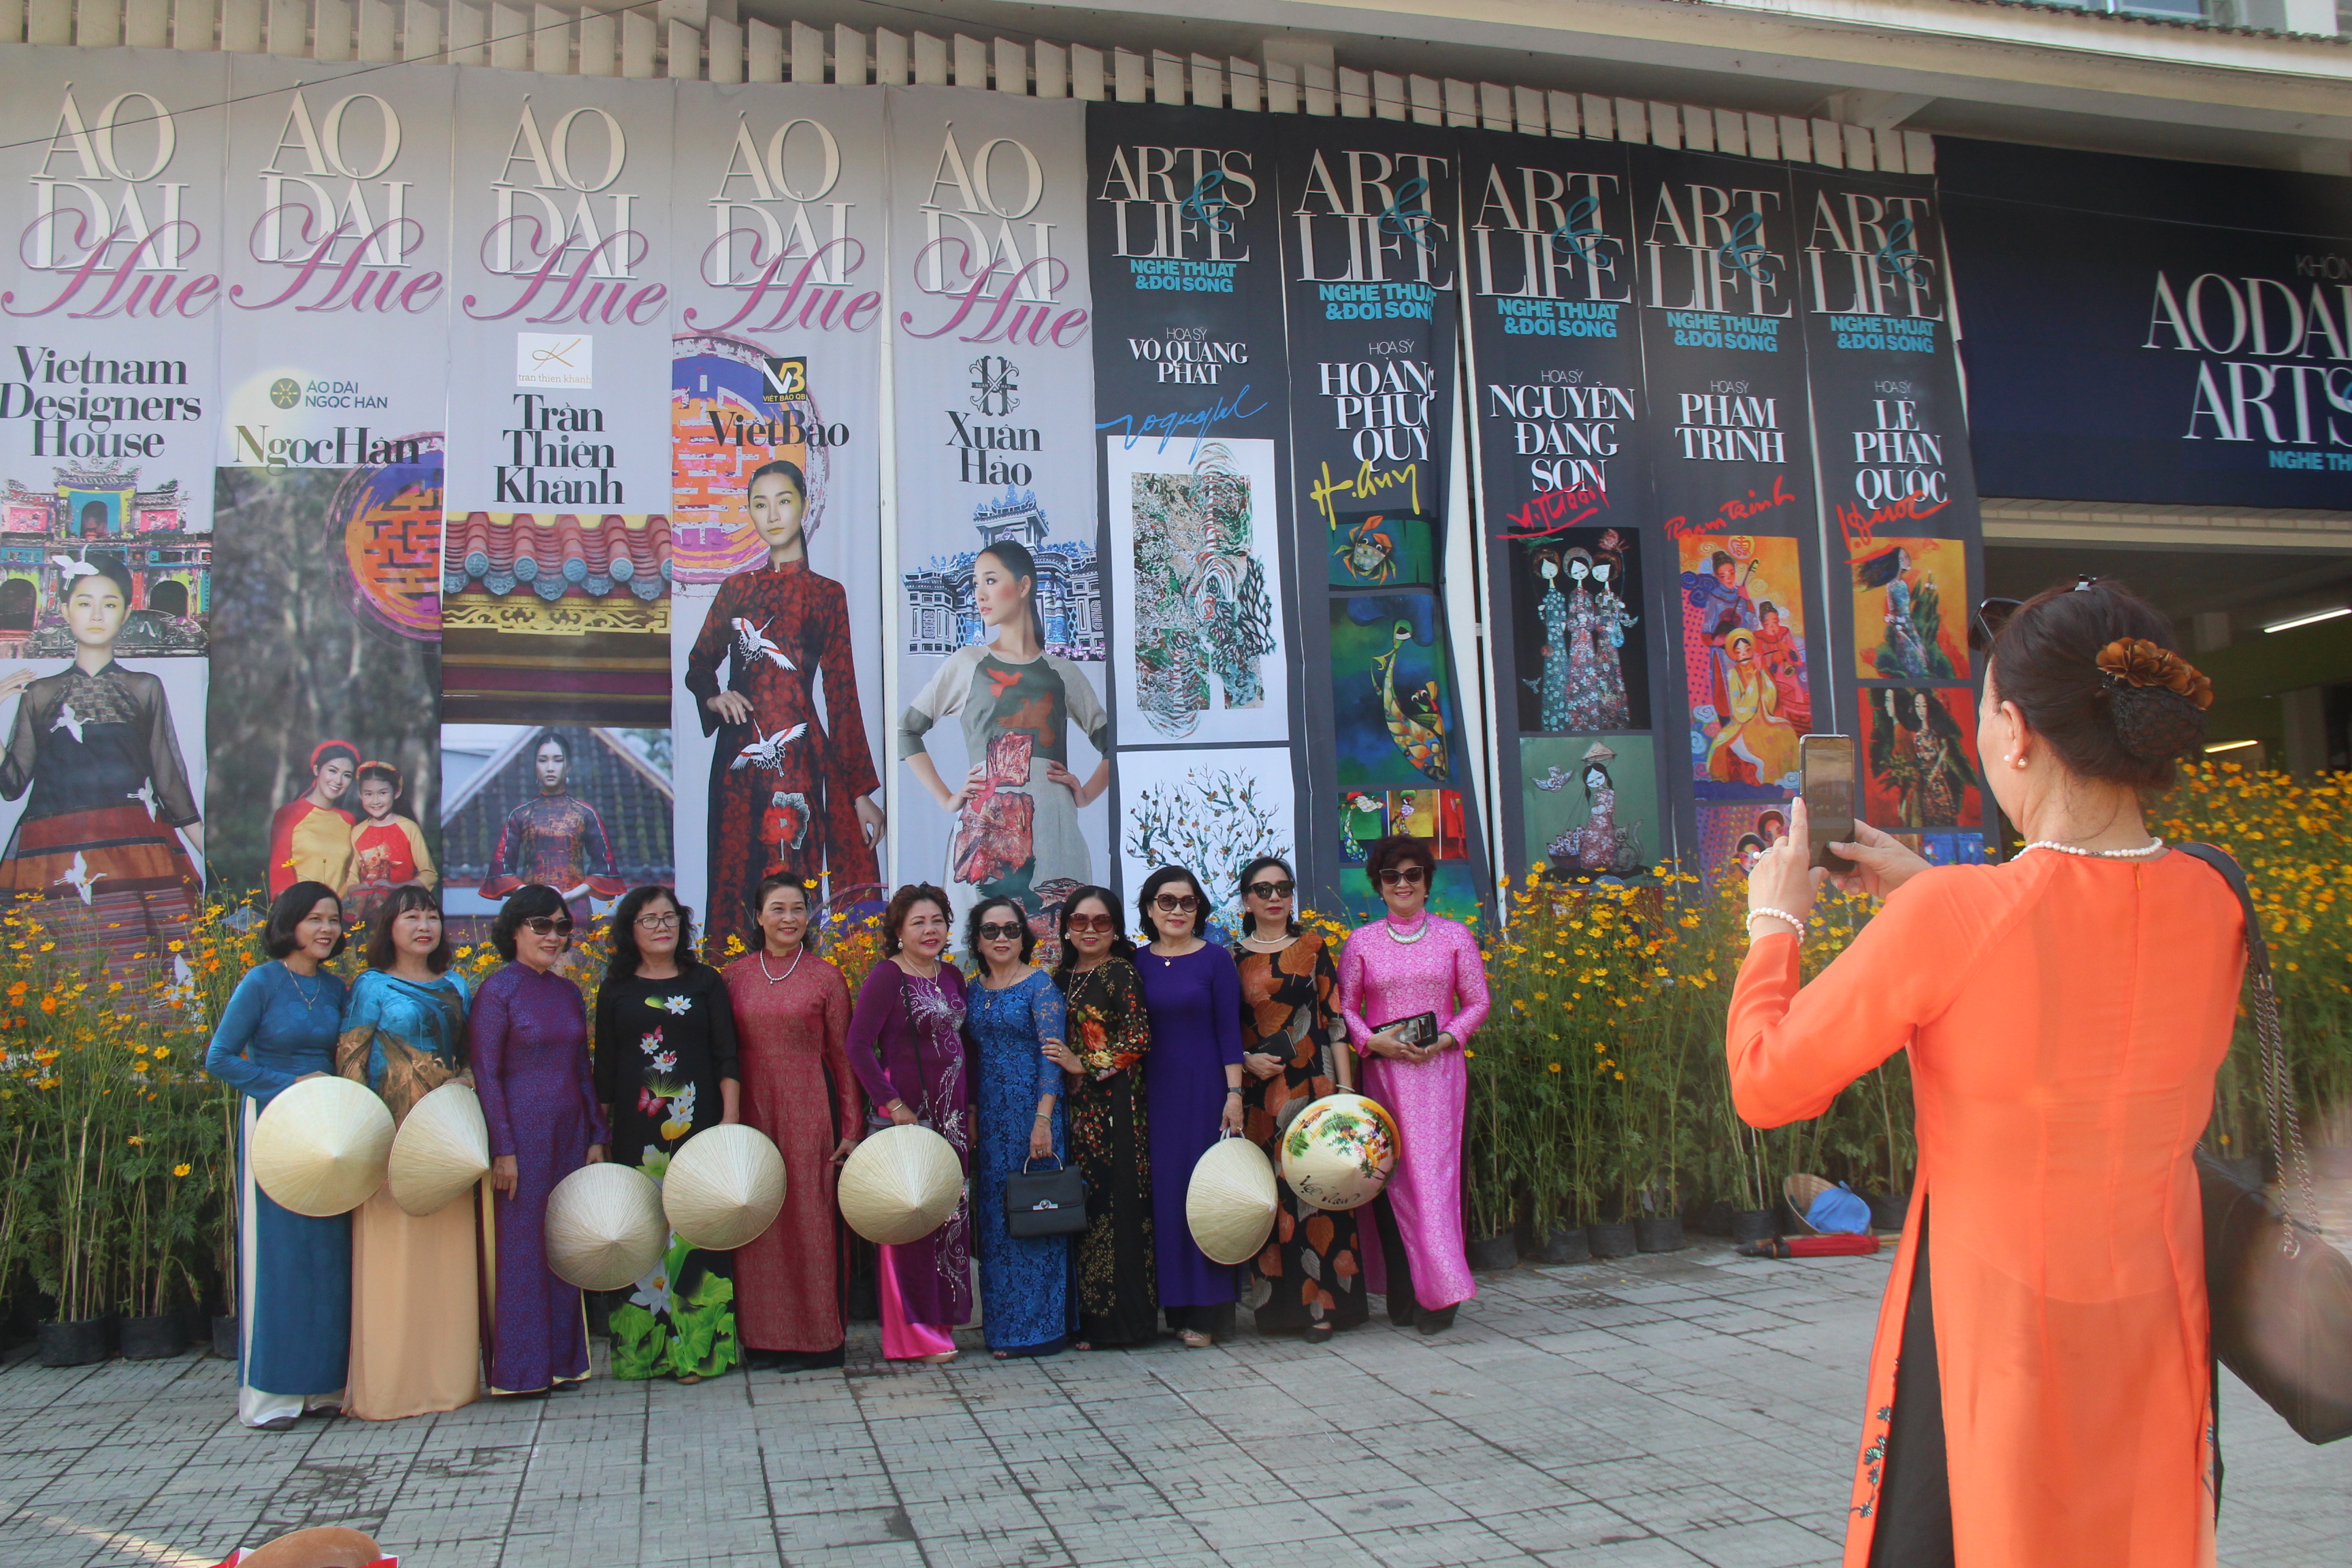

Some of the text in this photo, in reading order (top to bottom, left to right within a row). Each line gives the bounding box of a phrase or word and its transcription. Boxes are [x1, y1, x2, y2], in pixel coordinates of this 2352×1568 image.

[1096, 144, 1256, 208] ARTS
[1292, 148, 1449, 216] ART
[1471, 163, 1618, 234] ART
[1110, 200, 1250, 262] LIFE
[1645, 181, 1780, 250] ART
[1805, 189, 1928, 255] ART
[1, 208, 220, 318] Hue
[229, 203, 444, 313] Hue
[463, 214, 668, 325] Hue
[1292, 212, 1453, 291] LIFE
[1471, 227, 1631, 304] LIFE
[683, 228, 881, 332] Hue
[900, 237, 1088, 347] Hue
[1643, 242, 1793, 319] LIFE
[1803, 248, 1944, 323] LIFE
[1384, 299, 1432, 325] SỐN
[14, 345, 189, 385] Vietnam
[1165, 340, 1249, 368] QUANG
[539, 374, 561, 382] thien
[564, 375, 592, 384] khanh
[1488, 381, 1635, 421] NGUYỄN
[0, 382, 201, 433] Designers
[514, 393, 605, 431] Trần
[945, 410, 1043, 451] Xuân
[1873, 397, 1920, 431] LÊ
[31, 419, 165, 458] House
[503, 429, 617, 471] Thiện
[1514, 419, 1619, 456] ĐĂNG
[1852, 431, 1942, 466] PHAN
[493, 466, 625, 504] Khánh
[958, 446, 1032, 486] Hảo
[1532, 459, 1607, 493] SƠN
[1855, 465, 1948, 510] QUỐC
